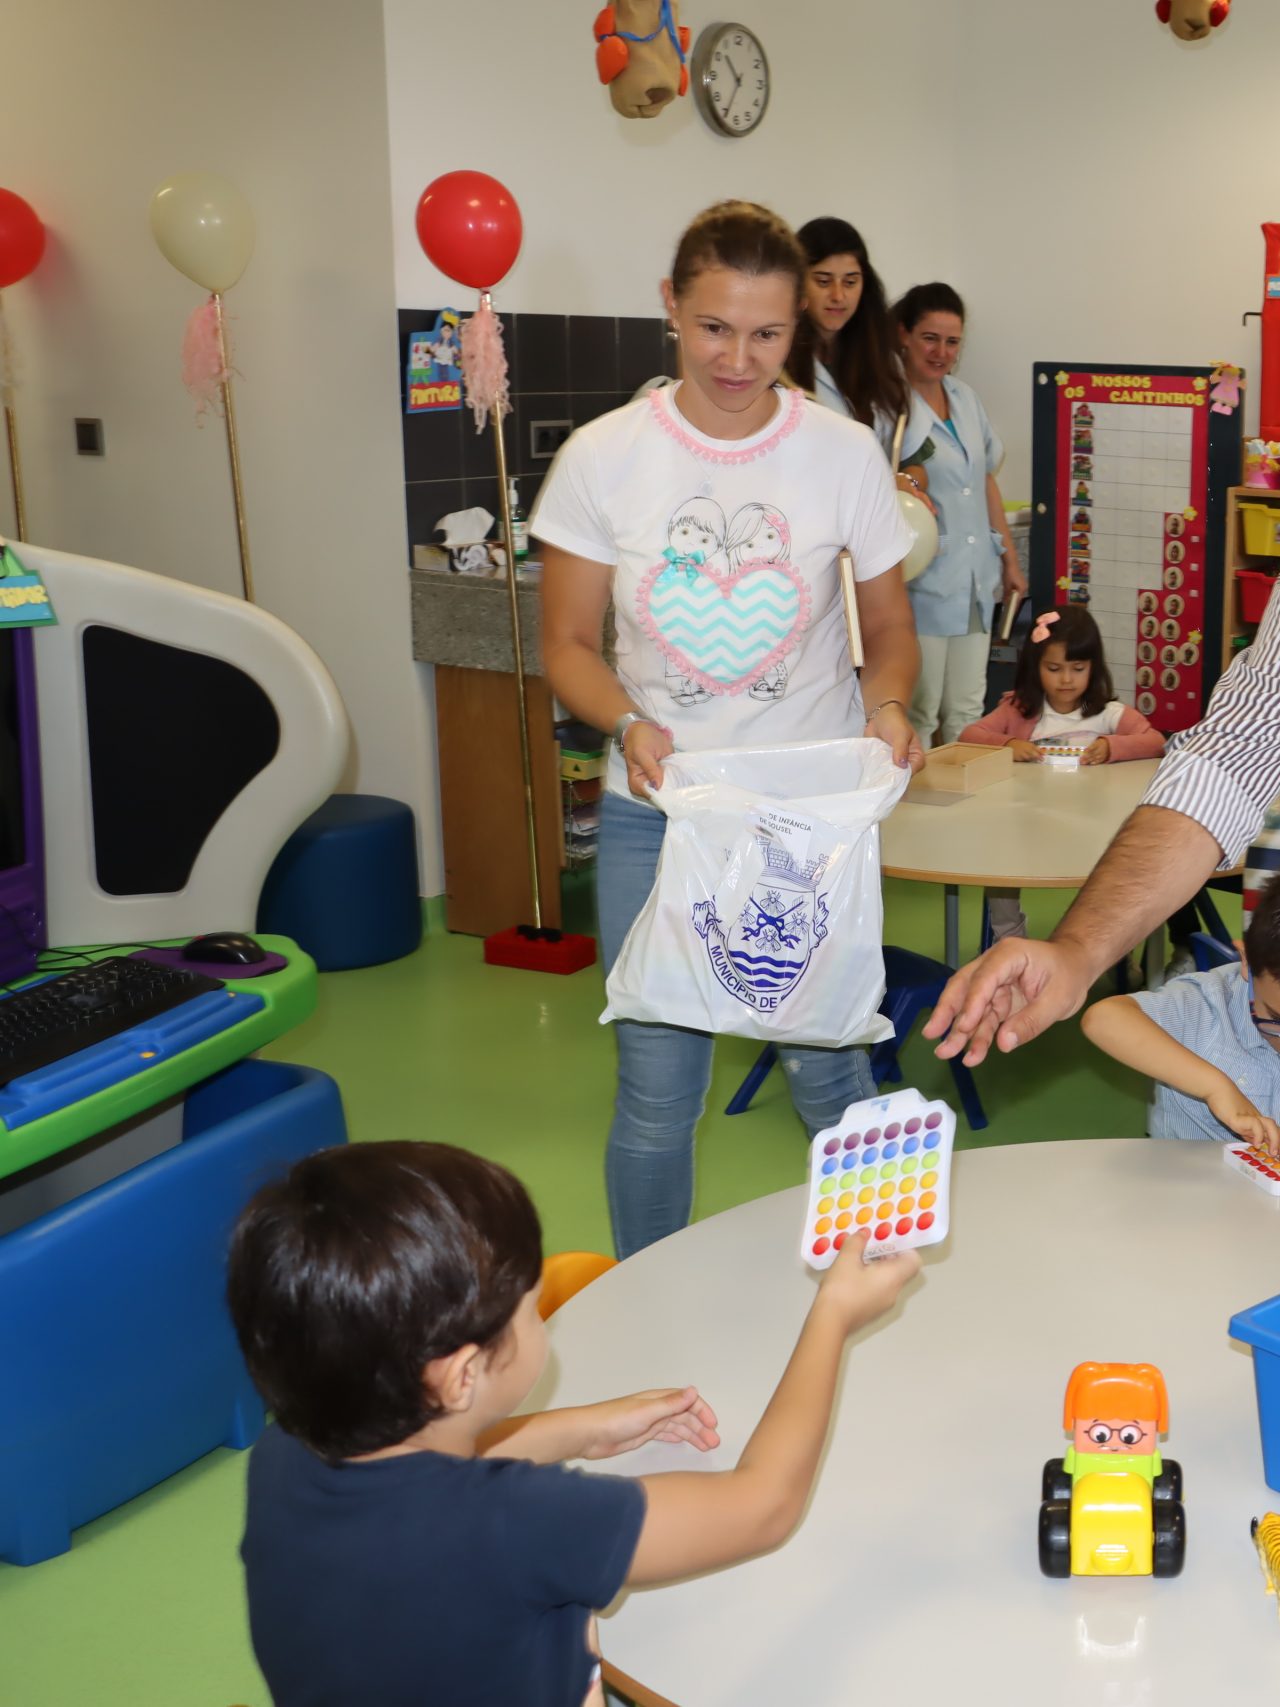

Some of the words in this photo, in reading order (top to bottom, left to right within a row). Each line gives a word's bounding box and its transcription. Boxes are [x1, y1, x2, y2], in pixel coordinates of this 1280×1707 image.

[1064, 385, 1085, 399] OS
[1091, 375, 1152, 389] NOSSOS
[1109, 390, 1206, 406] CANTINHOS
[759, 997, 777, 1008] DE
